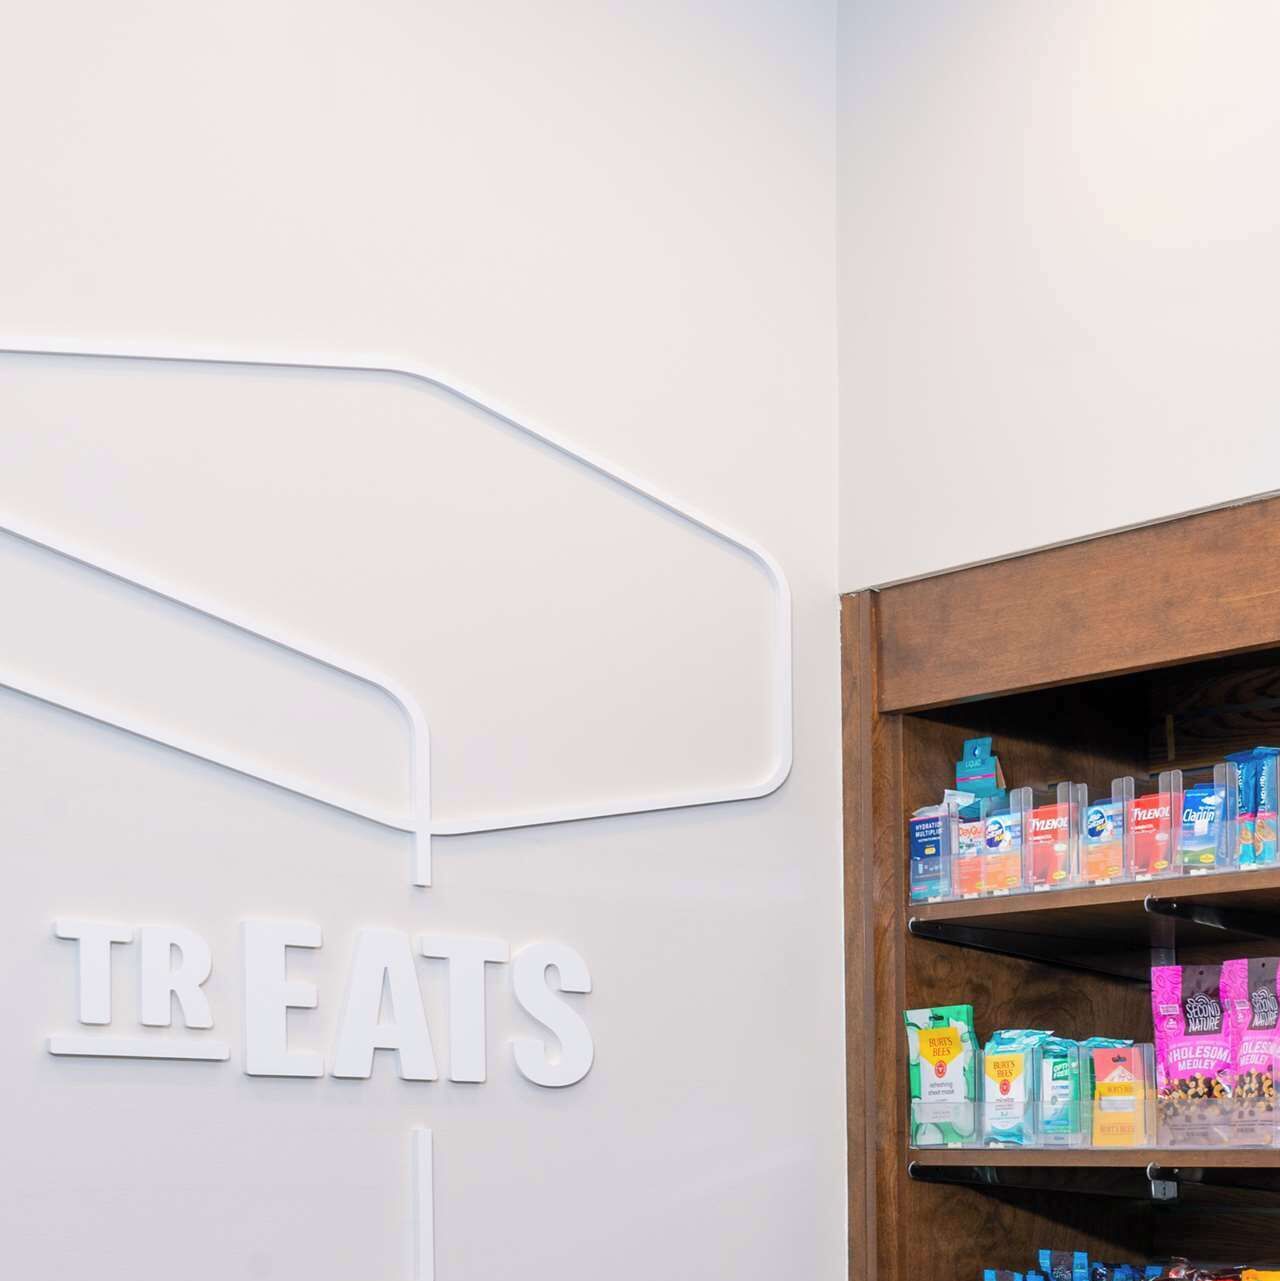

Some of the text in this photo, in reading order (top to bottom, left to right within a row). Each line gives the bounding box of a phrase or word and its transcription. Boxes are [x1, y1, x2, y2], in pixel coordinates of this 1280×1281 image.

[1131, 807, 1172, 822] TYLENOL
[1030, 817, 1070, 833] TYLENOL
[1186, 1000, 1221, 1020] SECOND
[1188, 1016, 1221, 1033] NATURE
[933, 1047, 951, 1057] BEES
[1177, 1059, 1217, 1072] MEDLEY
